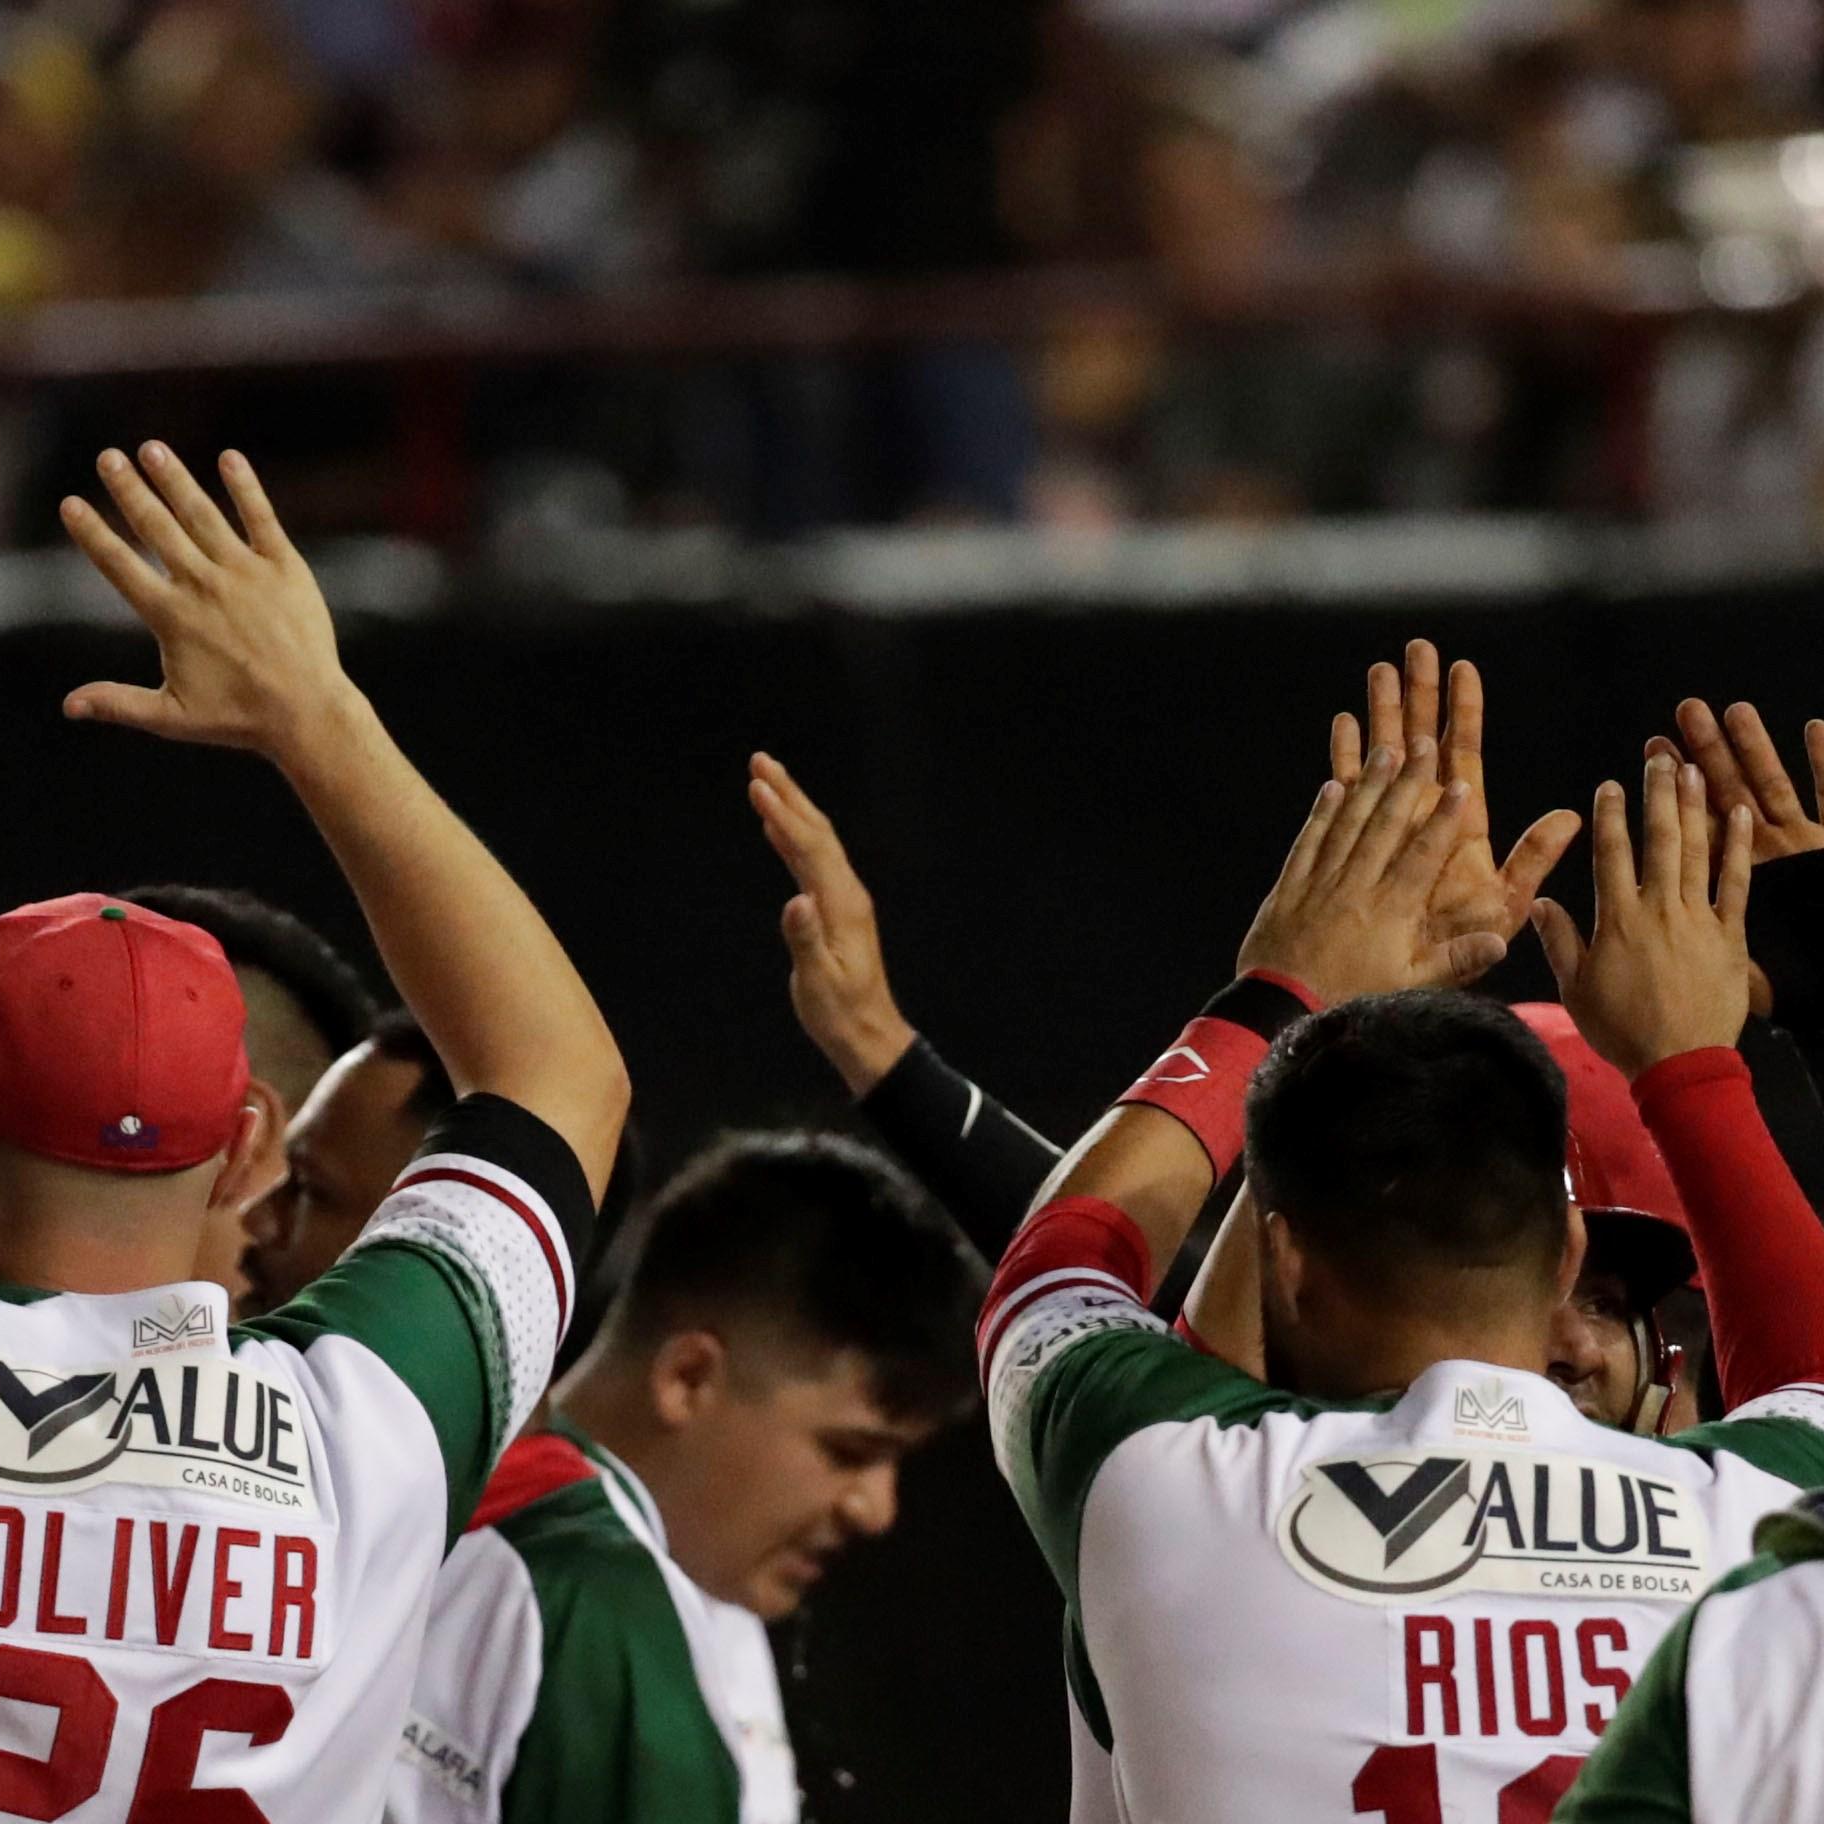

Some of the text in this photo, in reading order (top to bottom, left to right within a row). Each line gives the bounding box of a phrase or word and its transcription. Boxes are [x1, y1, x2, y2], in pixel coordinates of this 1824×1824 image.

[182, 1468, 304, 1508] CASA DE BOLSA
[1316, 1456, 1692, 1571] VALUE
[1540, 1571, 1693, 1594] CASA DE BOLSA
[1403, 1614, 1632, 1737] RIOS
